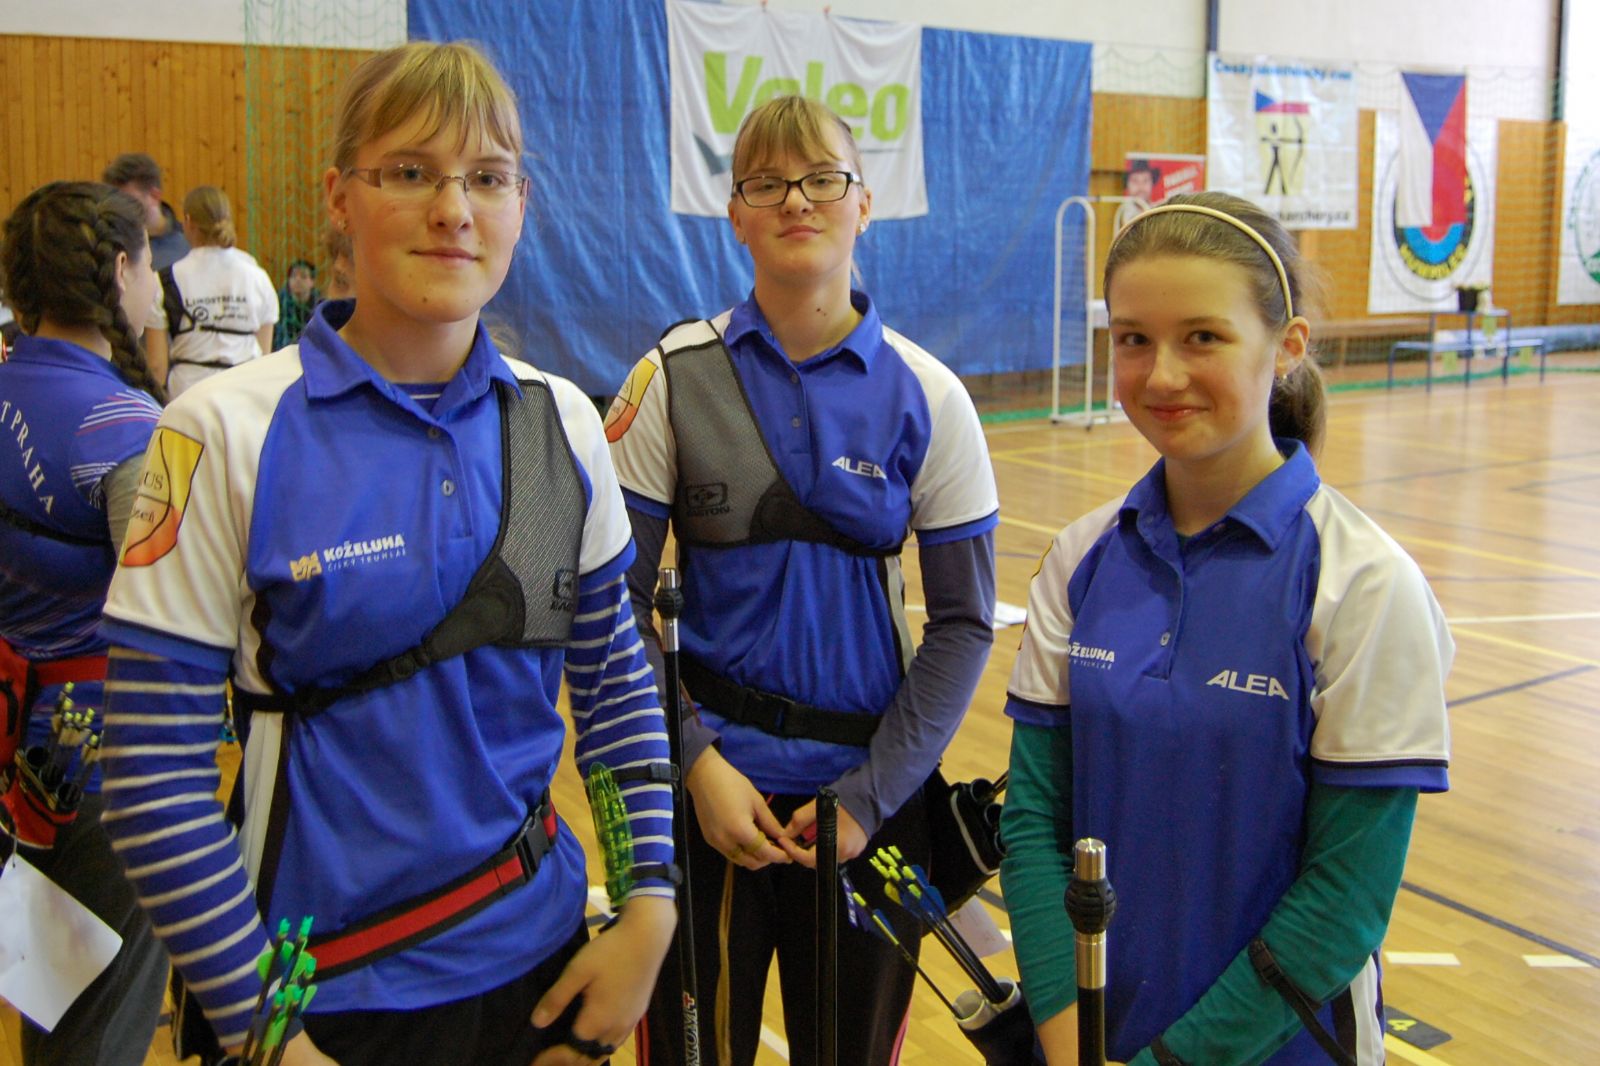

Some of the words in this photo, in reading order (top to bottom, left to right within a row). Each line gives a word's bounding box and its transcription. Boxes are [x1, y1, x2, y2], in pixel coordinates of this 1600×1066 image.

[10, 408, 54, 514] PRAHA
[831, 455, 887, 480] ALEA
[323, 533, 405, 563] KOŽELUHA
[1206, 669, 1290, 701] ALEA
